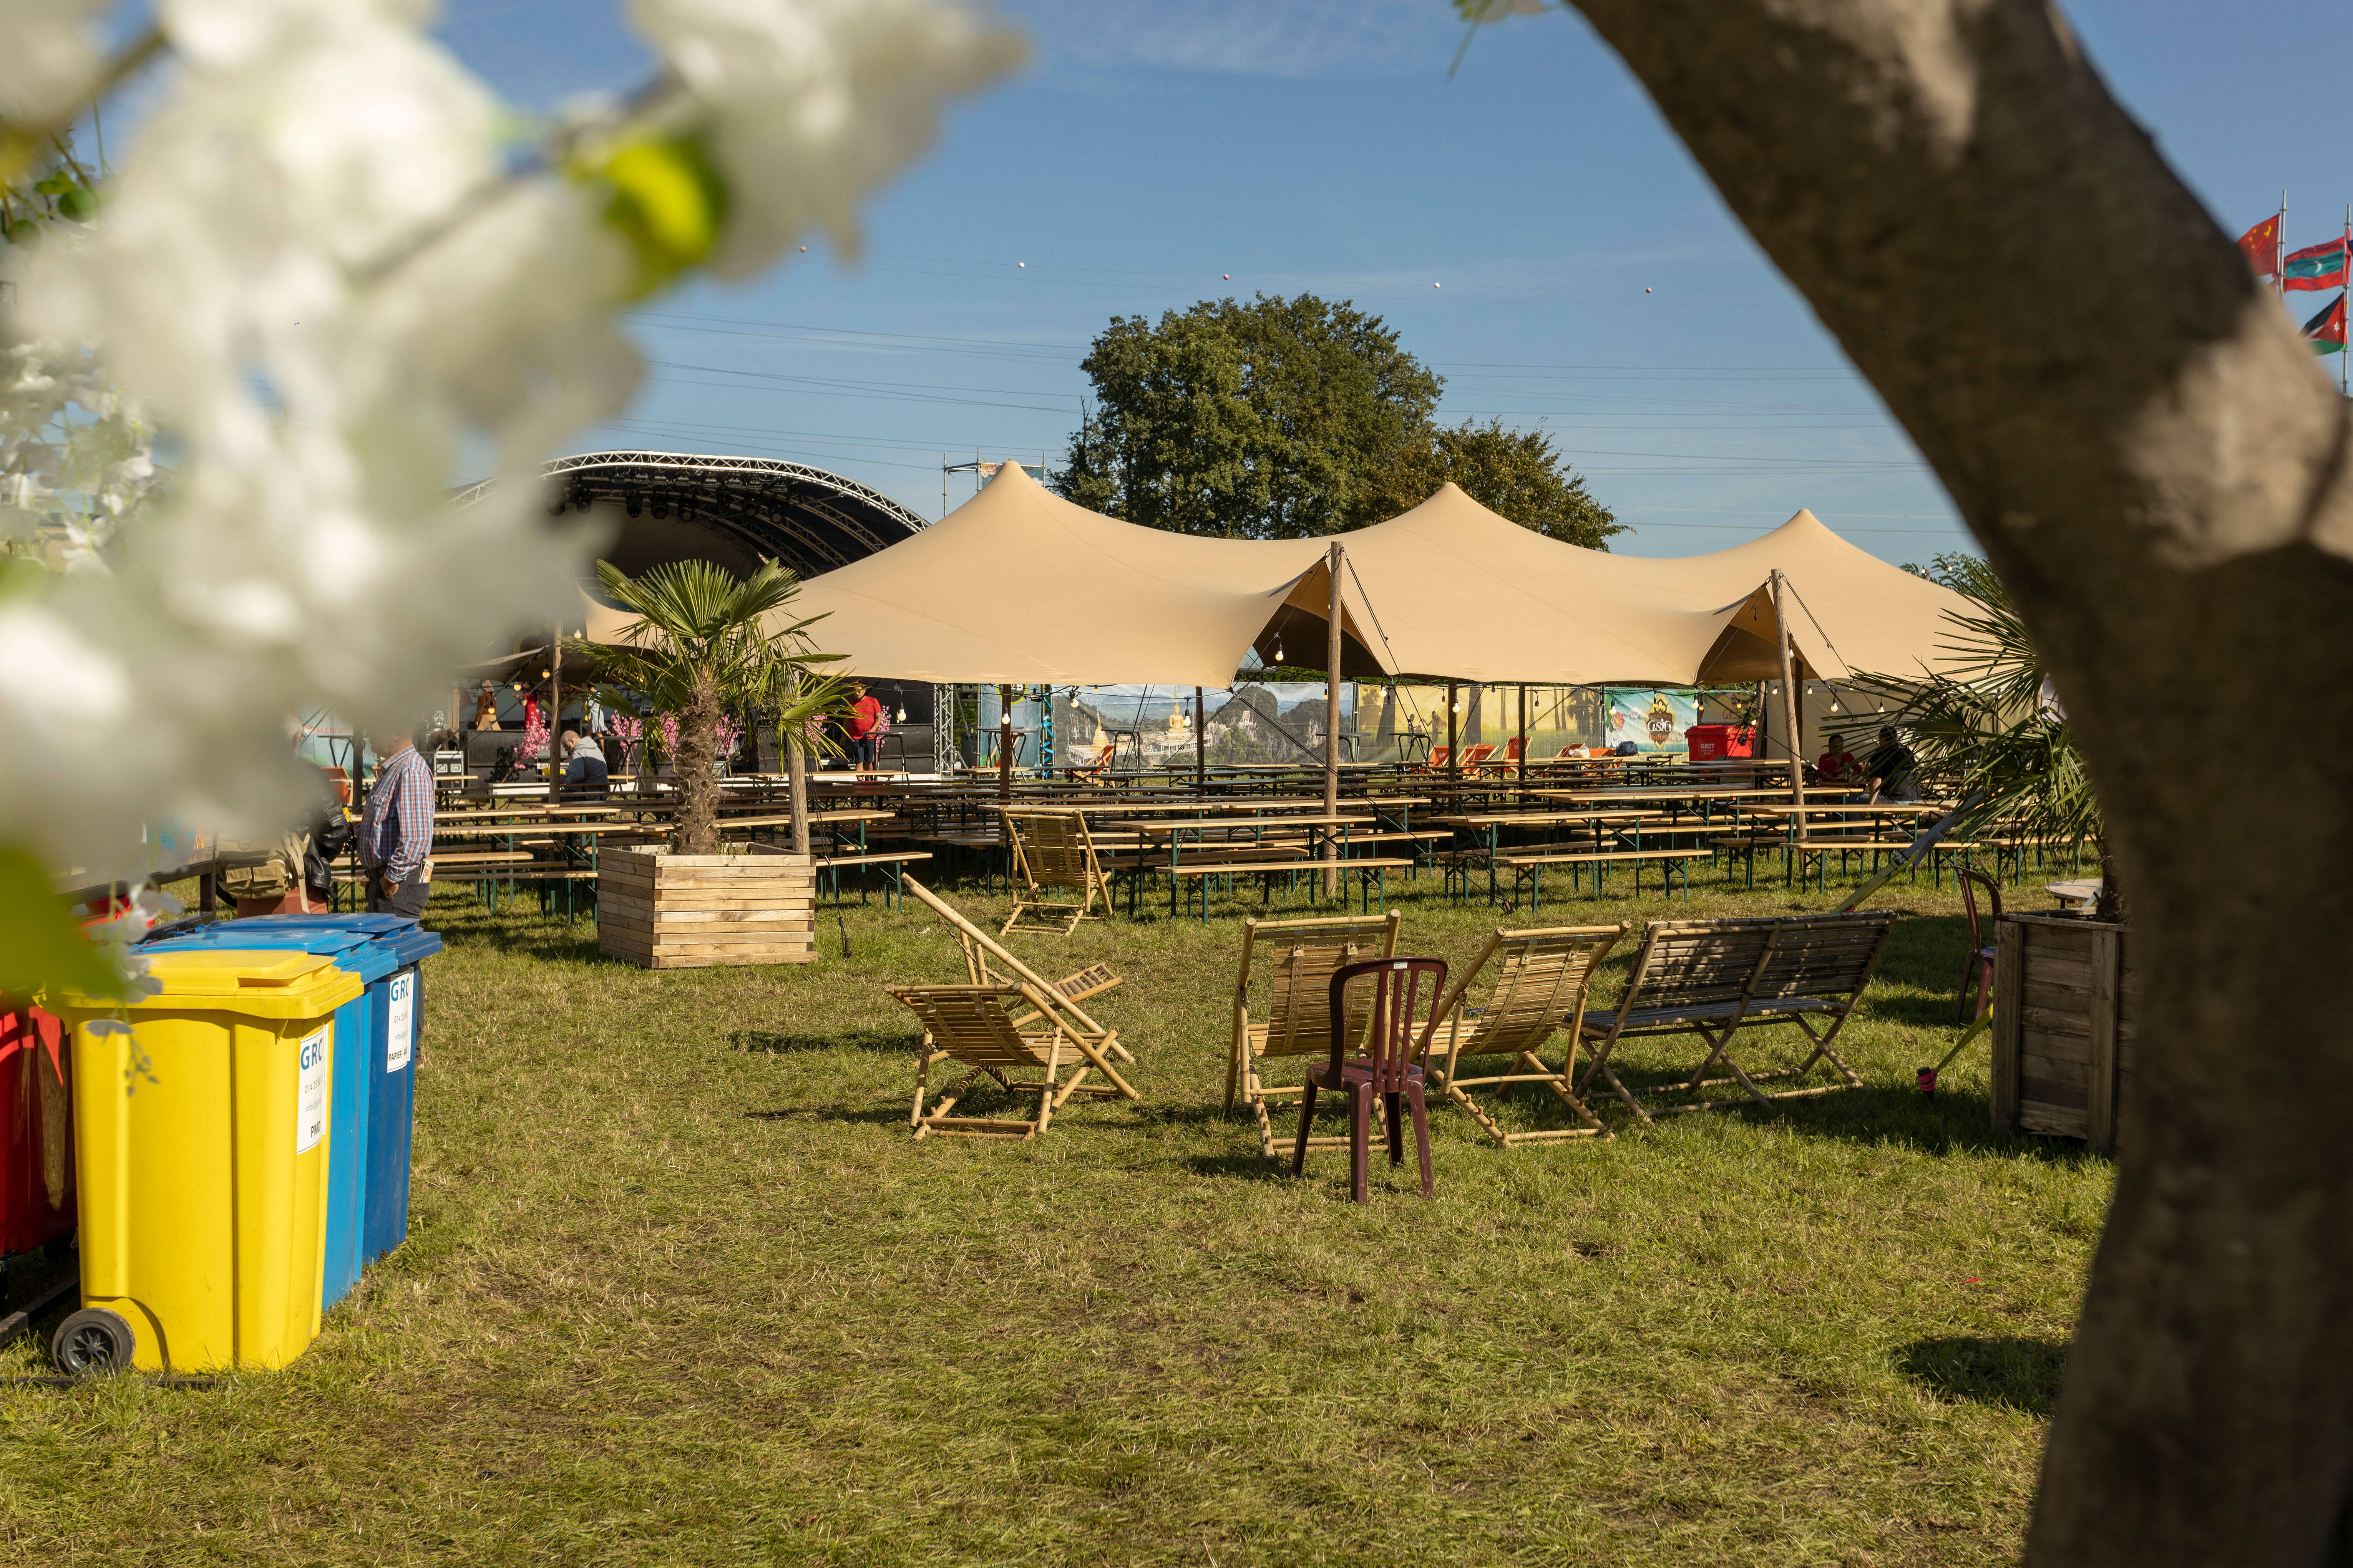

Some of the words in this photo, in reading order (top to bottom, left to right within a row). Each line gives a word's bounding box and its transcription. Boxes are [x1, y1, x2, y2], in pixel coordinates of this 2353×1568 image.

[1649, 733, 1670, 741] festival
[389, 1051, 402, 1061] PAPIER
[311, 1120, 320, 1138] PMD
